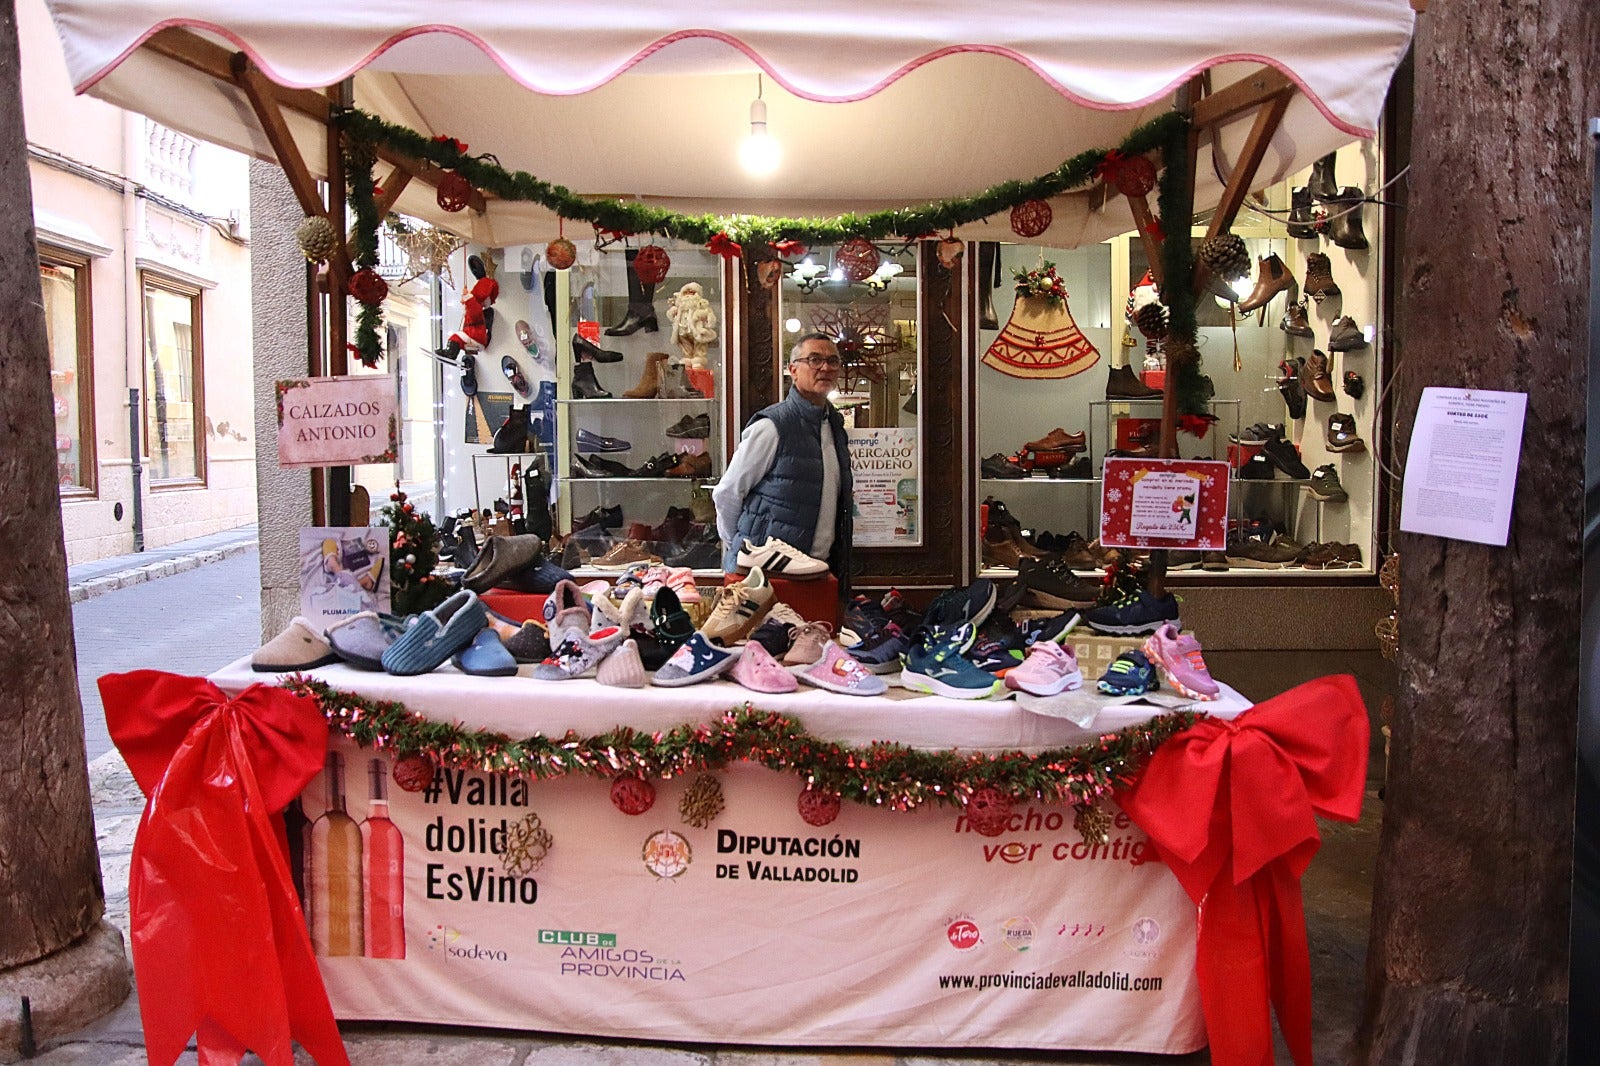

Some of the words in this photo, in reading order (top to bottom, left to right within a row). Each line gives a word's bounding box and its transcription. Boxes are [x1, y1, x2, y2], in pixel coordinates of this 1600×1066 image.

[289, 401, 380, 420] CALZADOS
[297, 424, 376, 442] ANTONIO
[848, 439, 879, 447] empryc
[422, 767, 529, 807] #Valla
[425, 815, 508, 855] dolid
[716, 828, 861, 858] DIPUTACIÓN
[716, 864, 740, 879] DE
[746, 860, 859, 883] VALLADOLID
[426, 863, 538, 905] EsVino
[541, 930, 600, 946] CLUB
[1006, 928, 1032, 938] RUEDA
[560, 946, 654, 964] AMIGOS
[561, 962, 686, 981] PROVINCIA
[939, 970, 1163, 991] www.provinciadevalladolid.com
